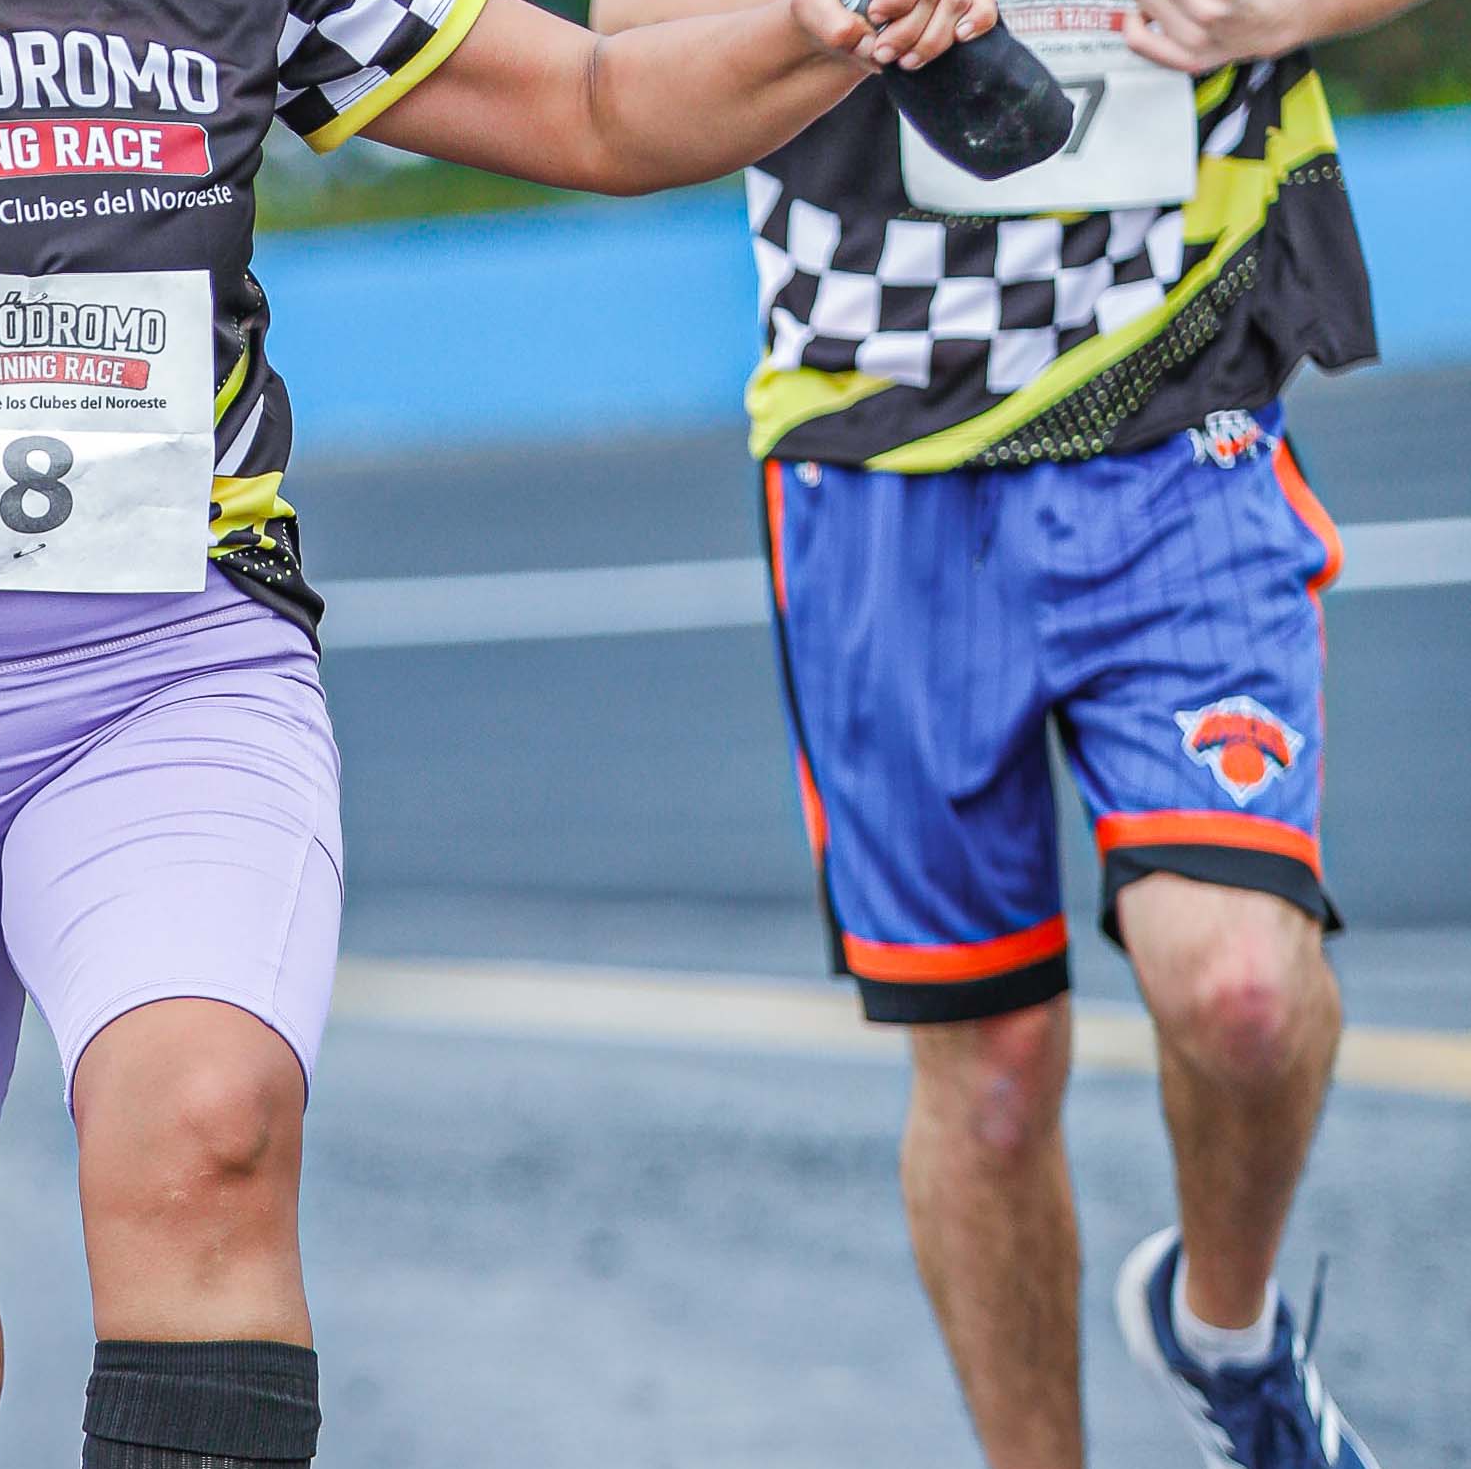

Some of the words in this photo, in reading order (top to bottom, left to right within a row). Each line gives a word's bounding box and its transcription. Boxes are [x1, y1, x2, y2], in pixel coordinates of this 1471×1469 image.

[53, 125, 164, 170] RACE
[94, 188, 135, 216] del
[140, 184, 232, 214] Noroeste
[64, 356, 125, 386] RACE
[6, 397, 26, 410] los
[29, 396, 77, 410] Clubes
[80, 396, 102, 410] del
[105, 396, 167, 410] Noroeste
[0, 435, 74, 534] 8
